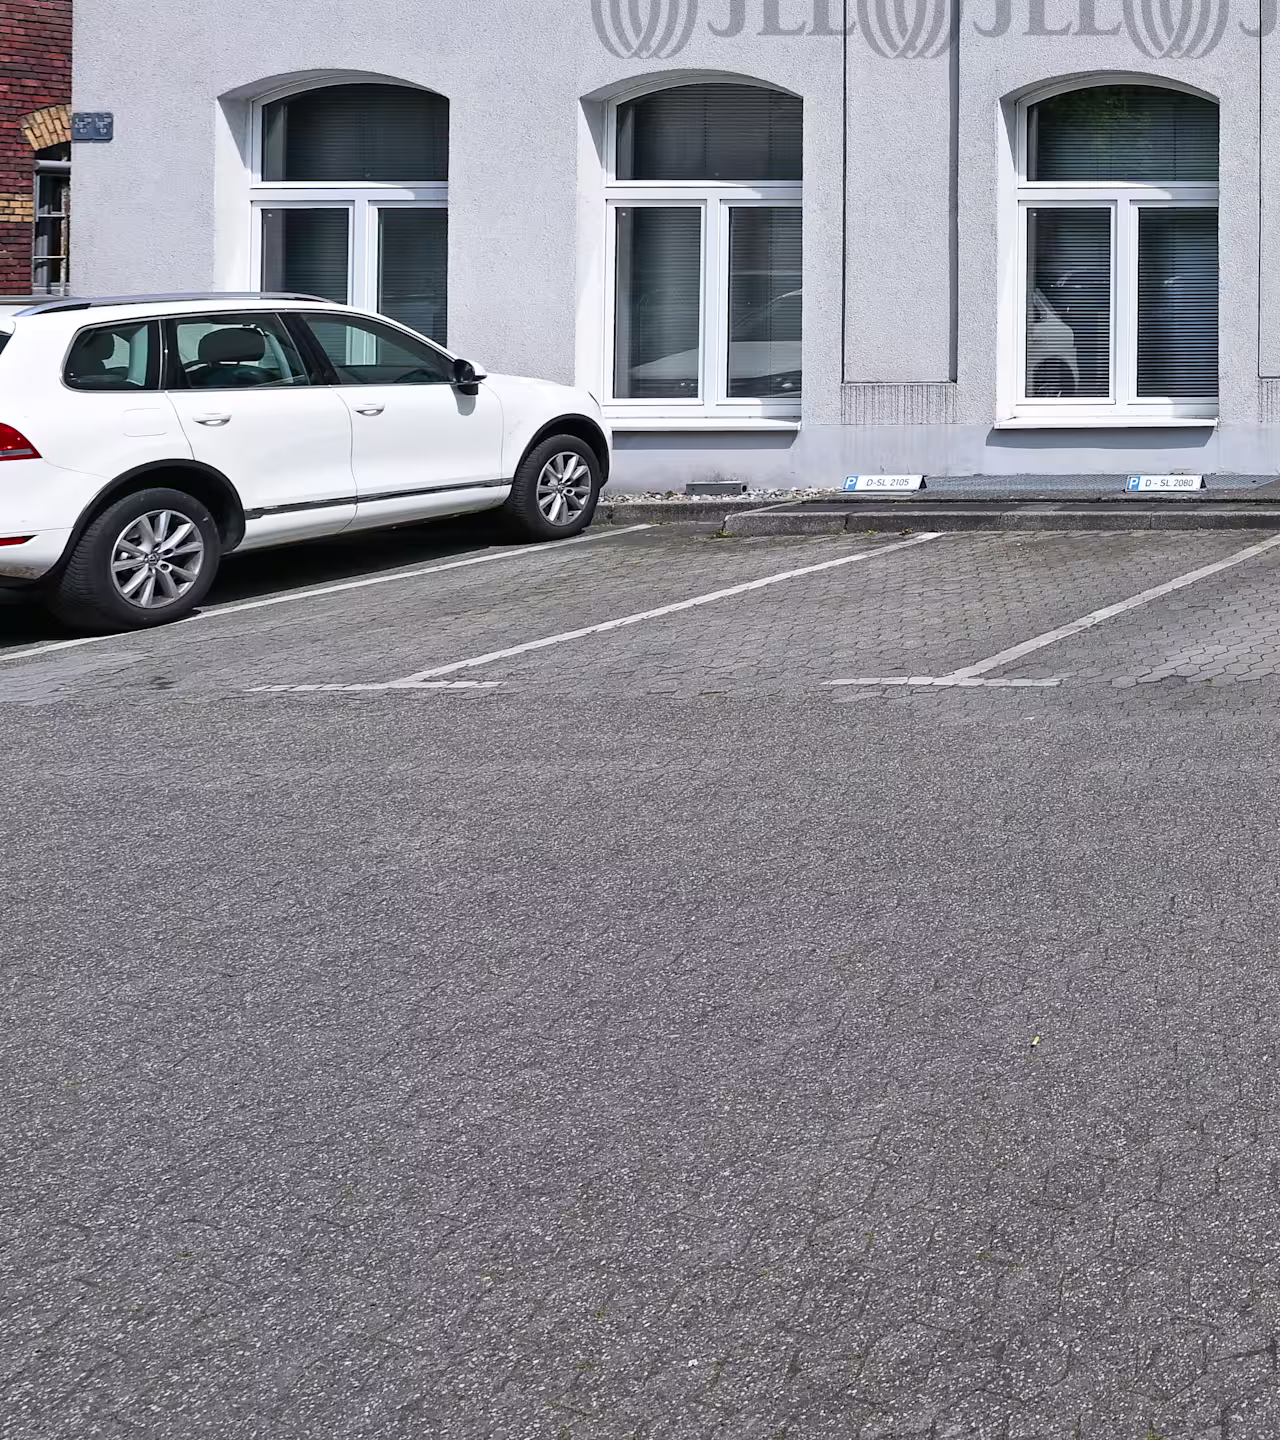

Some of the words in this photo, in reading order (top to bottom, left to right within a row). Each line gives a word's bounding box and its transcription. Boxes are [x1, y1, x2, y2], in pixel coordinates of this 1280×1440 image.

[845, 477, 857, 489] P
[890, 478, 910, 487] 2105
[1128, 477, 1139, 490] P
[1173, 479, 1193, 487] 2080
